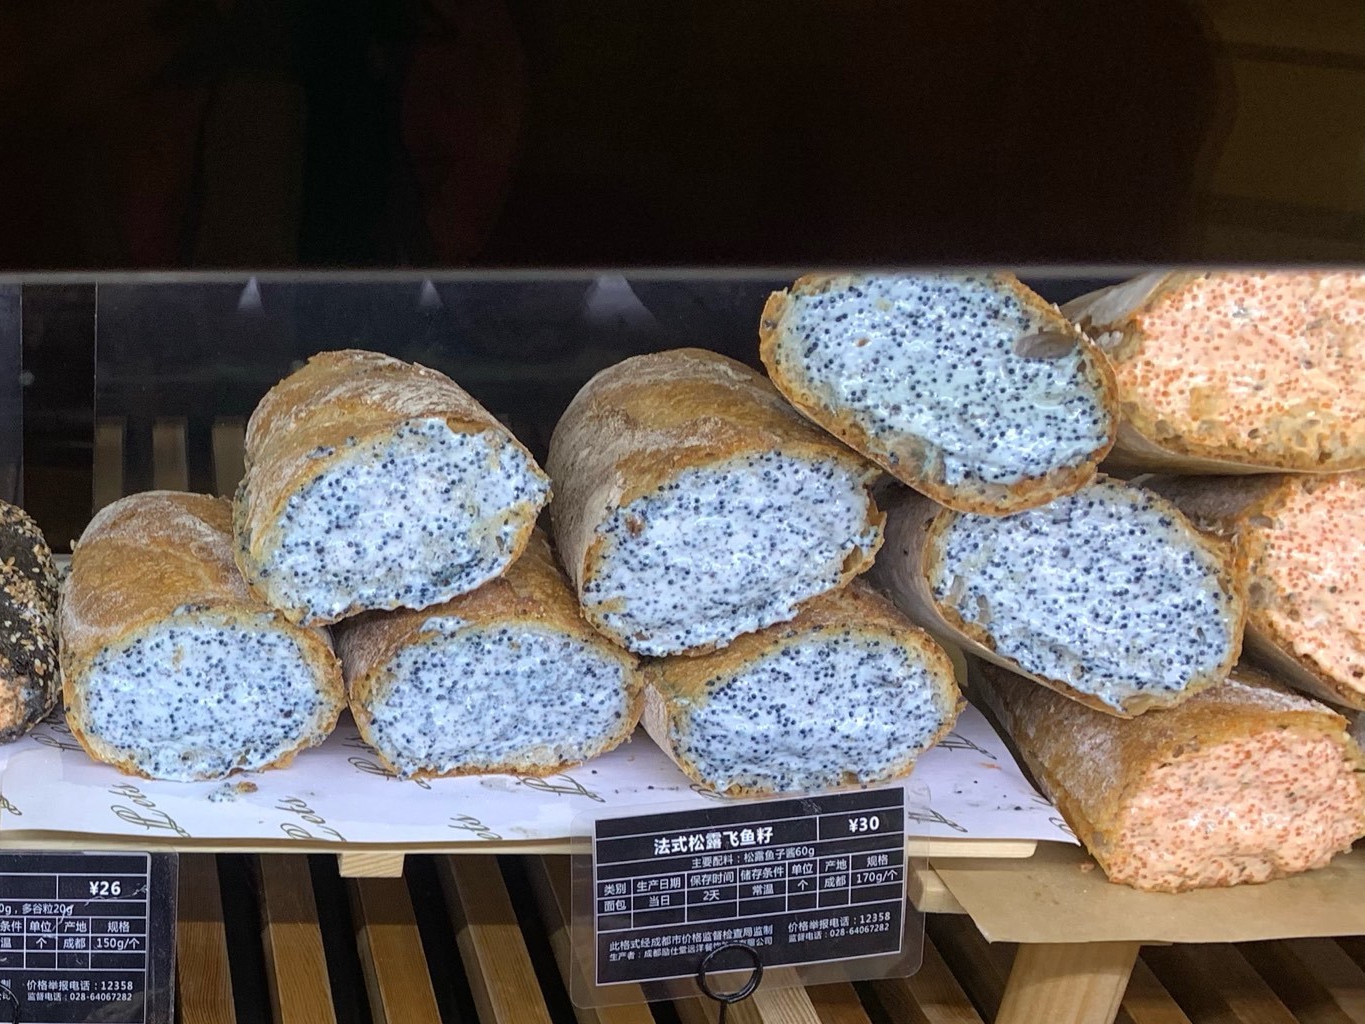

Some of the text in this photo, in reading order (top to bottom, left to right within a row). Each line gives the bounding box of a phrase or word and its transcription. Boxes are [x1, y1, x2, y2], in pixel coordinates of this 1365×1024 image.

[848, 815, 879, 833] ¥30
[653, 825, 773, 855] 法式松露飞鱼籽
[604, 853, 888, 896] 类别 生产日期 保存时间 储存条件 单位 产地 规格
[89, 880, 121, 898] ¥26
[603, 868, 897, 912] 面包 当日 2天 常温 个 成都 170g/个
[29, 920, 52, 932] 单位
[64, 920, 87, 932] 产地
[107, 921, 130, 933] 规格
[35, 937, 47, 949] 个
[63, 937, 85, 949] 成都
[96, 937, 140, 951] 150g/个
